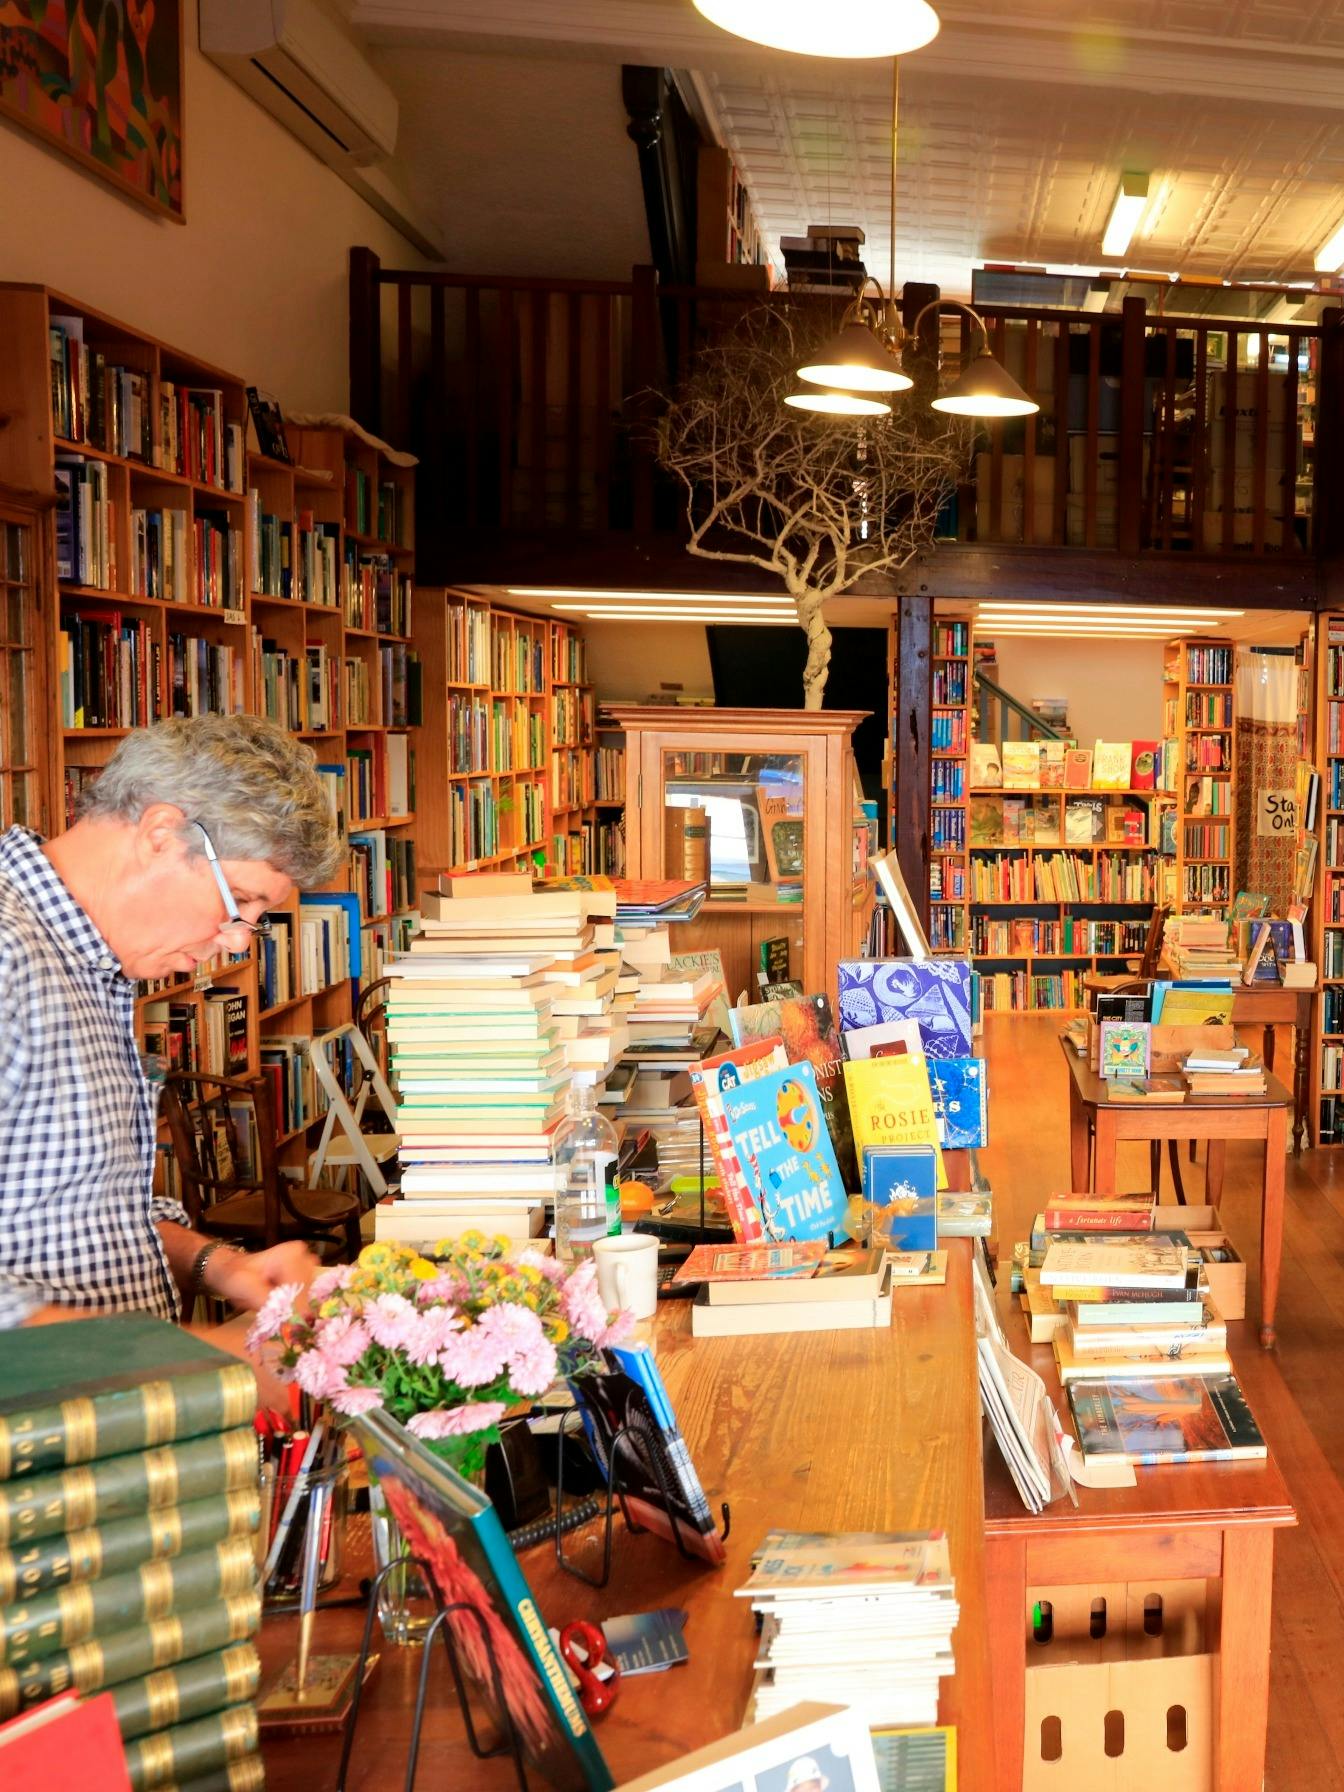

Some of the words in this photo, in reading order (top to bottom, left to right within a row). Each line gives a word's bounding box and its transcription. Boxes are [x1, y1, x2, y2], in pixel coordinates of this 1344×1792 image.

[1272, 814, 1295, 831] Onl
[722, 1075, 736, 1090] CAT
[871, 1108, 930, 1131] ROSIE
[734, 1120, 782, 1157] TELL
[881, 1129, 931, 1144] PROJECT
[777, 1155, 800, 1181] THE
[779, 1180, 833, 1228] TIME
[1109, 1216, 1122, 1226] life
